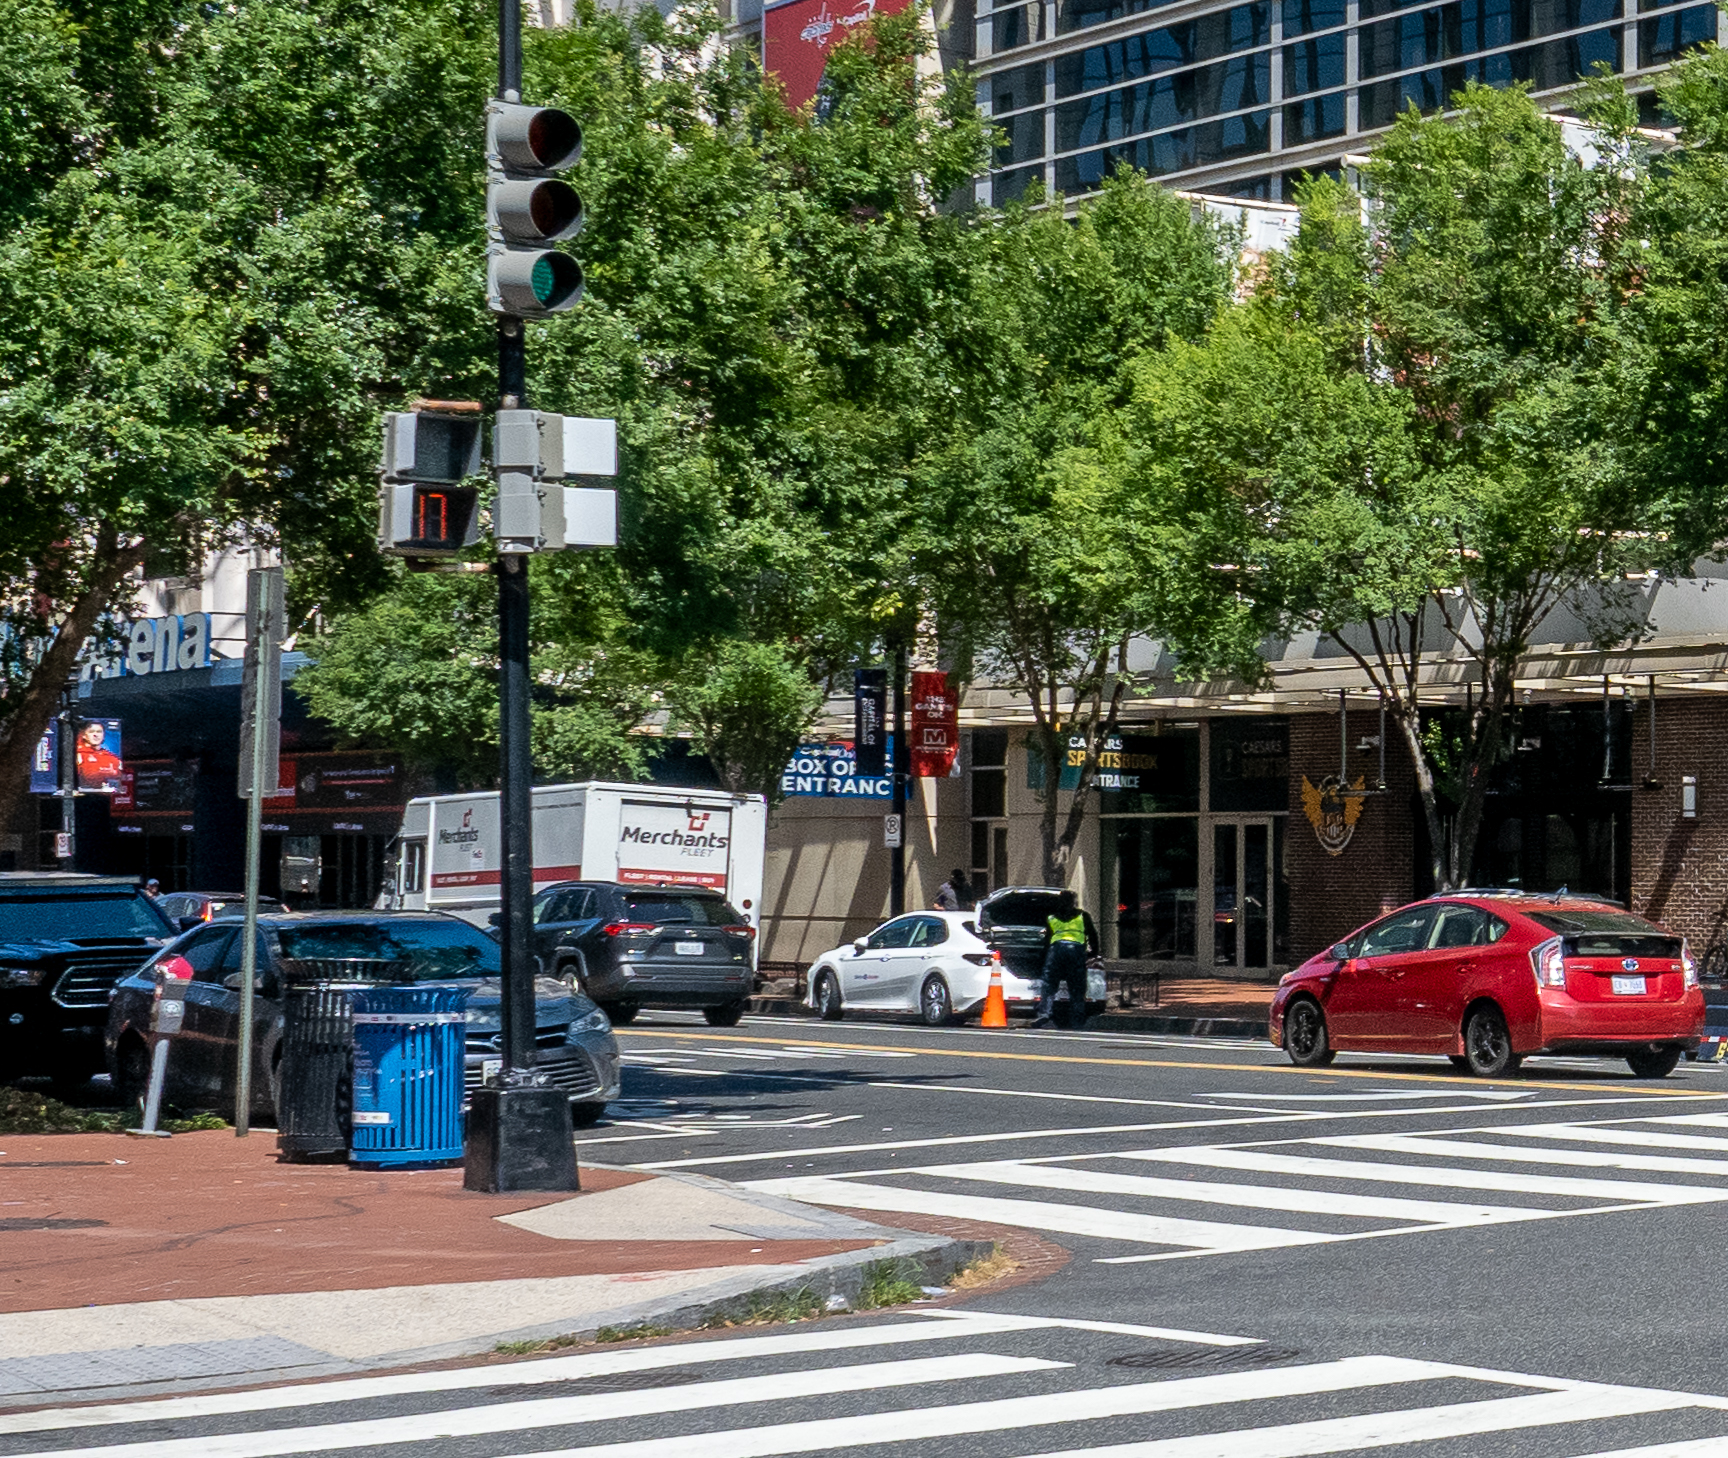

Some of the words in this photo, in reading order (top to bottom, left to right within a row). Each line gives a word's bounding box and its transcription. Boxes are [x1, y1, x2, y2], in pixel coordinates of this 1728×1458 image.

[785, 758, 828, 774] BOX
[781, 775, 890, 795] ENTRANC
[438, 826, 479, 845] Merchants
[621, 826, 729, 849] Merchants
[681, 847, 714, 858] FLEET
